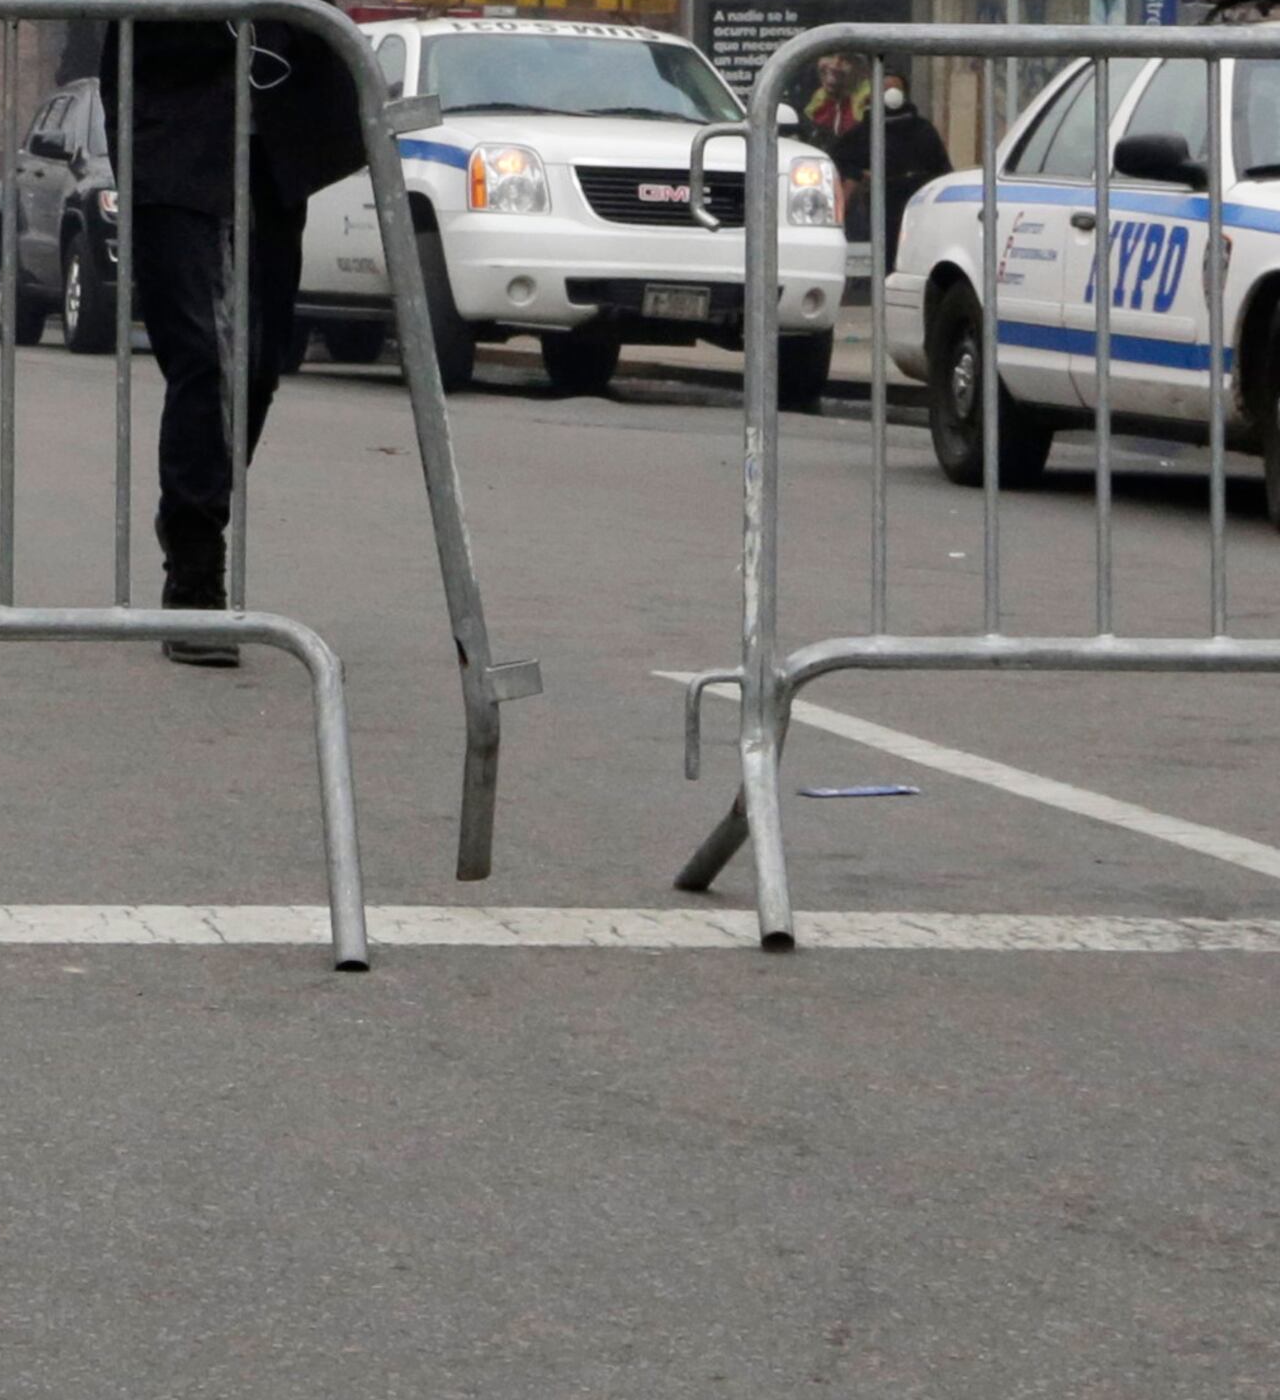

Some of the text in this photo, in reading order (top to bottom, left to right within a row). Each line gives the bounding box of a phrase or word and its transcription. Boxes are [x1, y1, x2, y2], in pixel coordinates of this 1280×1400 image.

[713, 10, 726, 22] A
[727, 9, 765, 22] nadie
[713, 26, 758, 38] ocurre
[713, 41, 740, 53] que
[1083, 219, 1190, 313] NYPD
